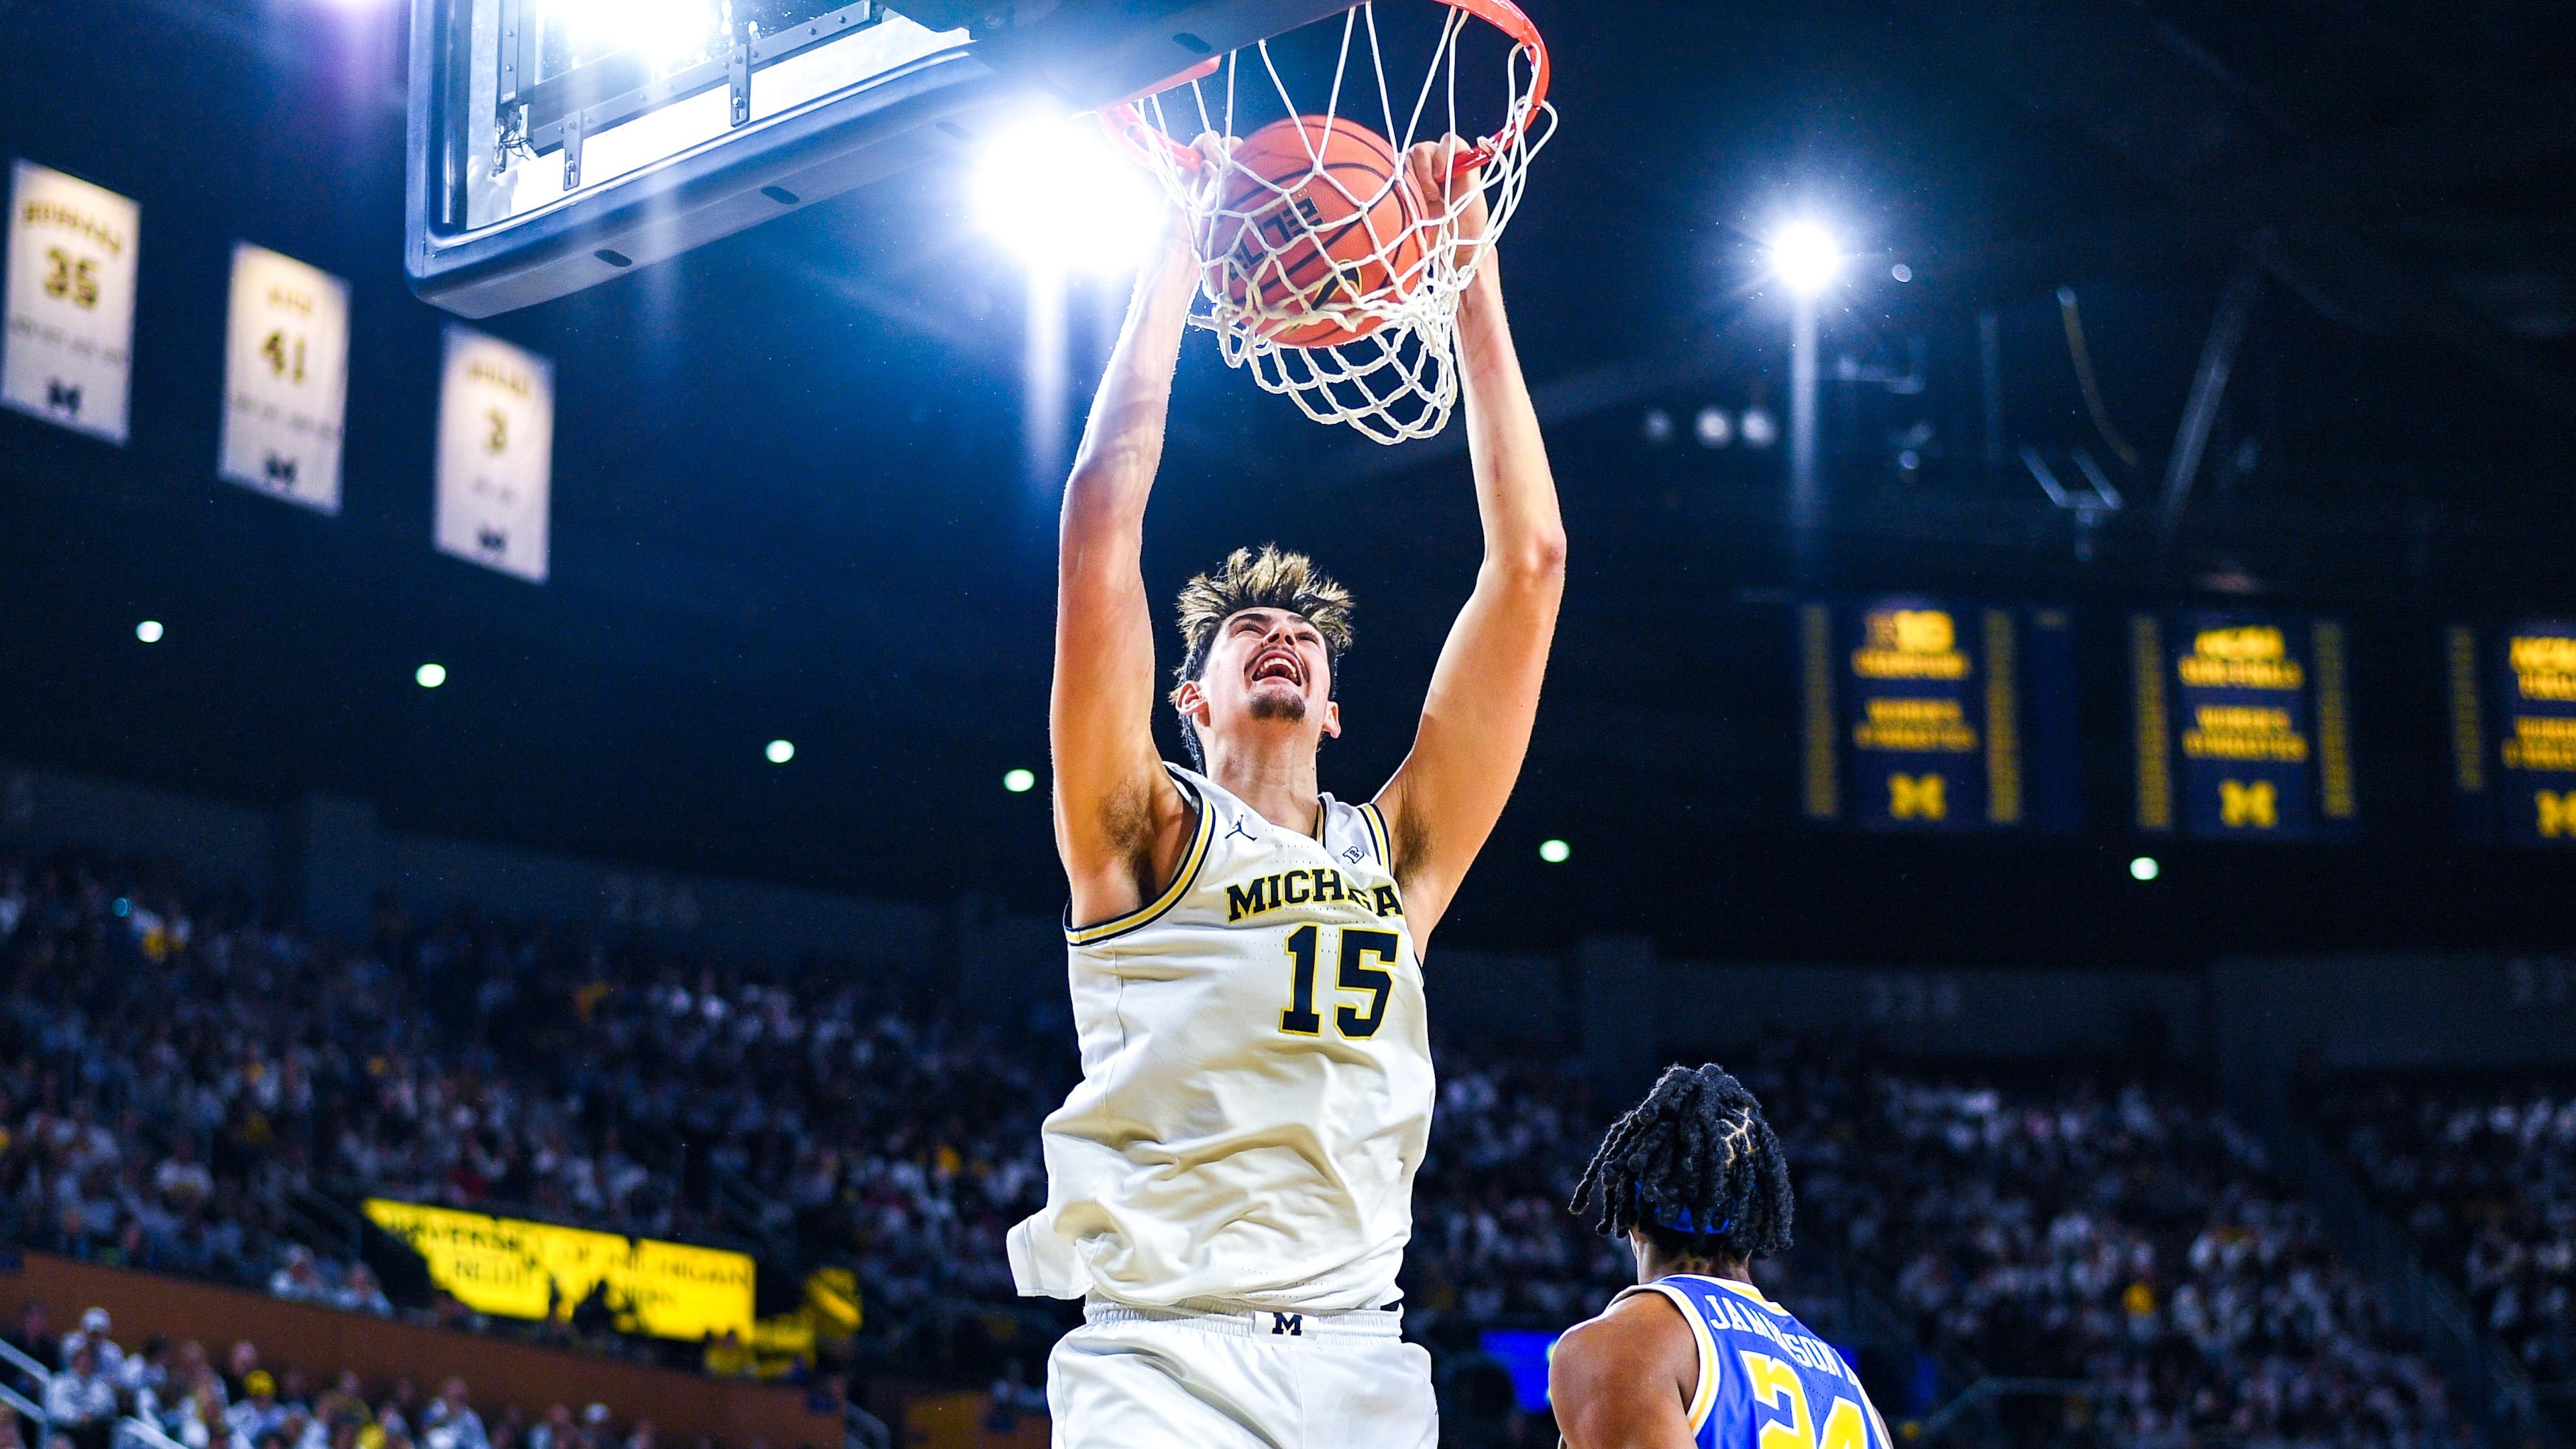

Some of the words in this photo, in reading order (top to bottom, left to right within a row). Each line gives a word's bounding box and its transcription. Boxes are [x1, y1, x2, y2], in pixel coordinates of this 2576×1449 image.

[44, 247, 99, 309] 35
[262, 331, 305, 382] 41
[1224, 868, 1405, 924] MICHGA
[1279, 922, 1400, 1040] 15
[1272, 1312, 1303, 1336] M
[1705, 1295, 1842, 1378] JAMSON
